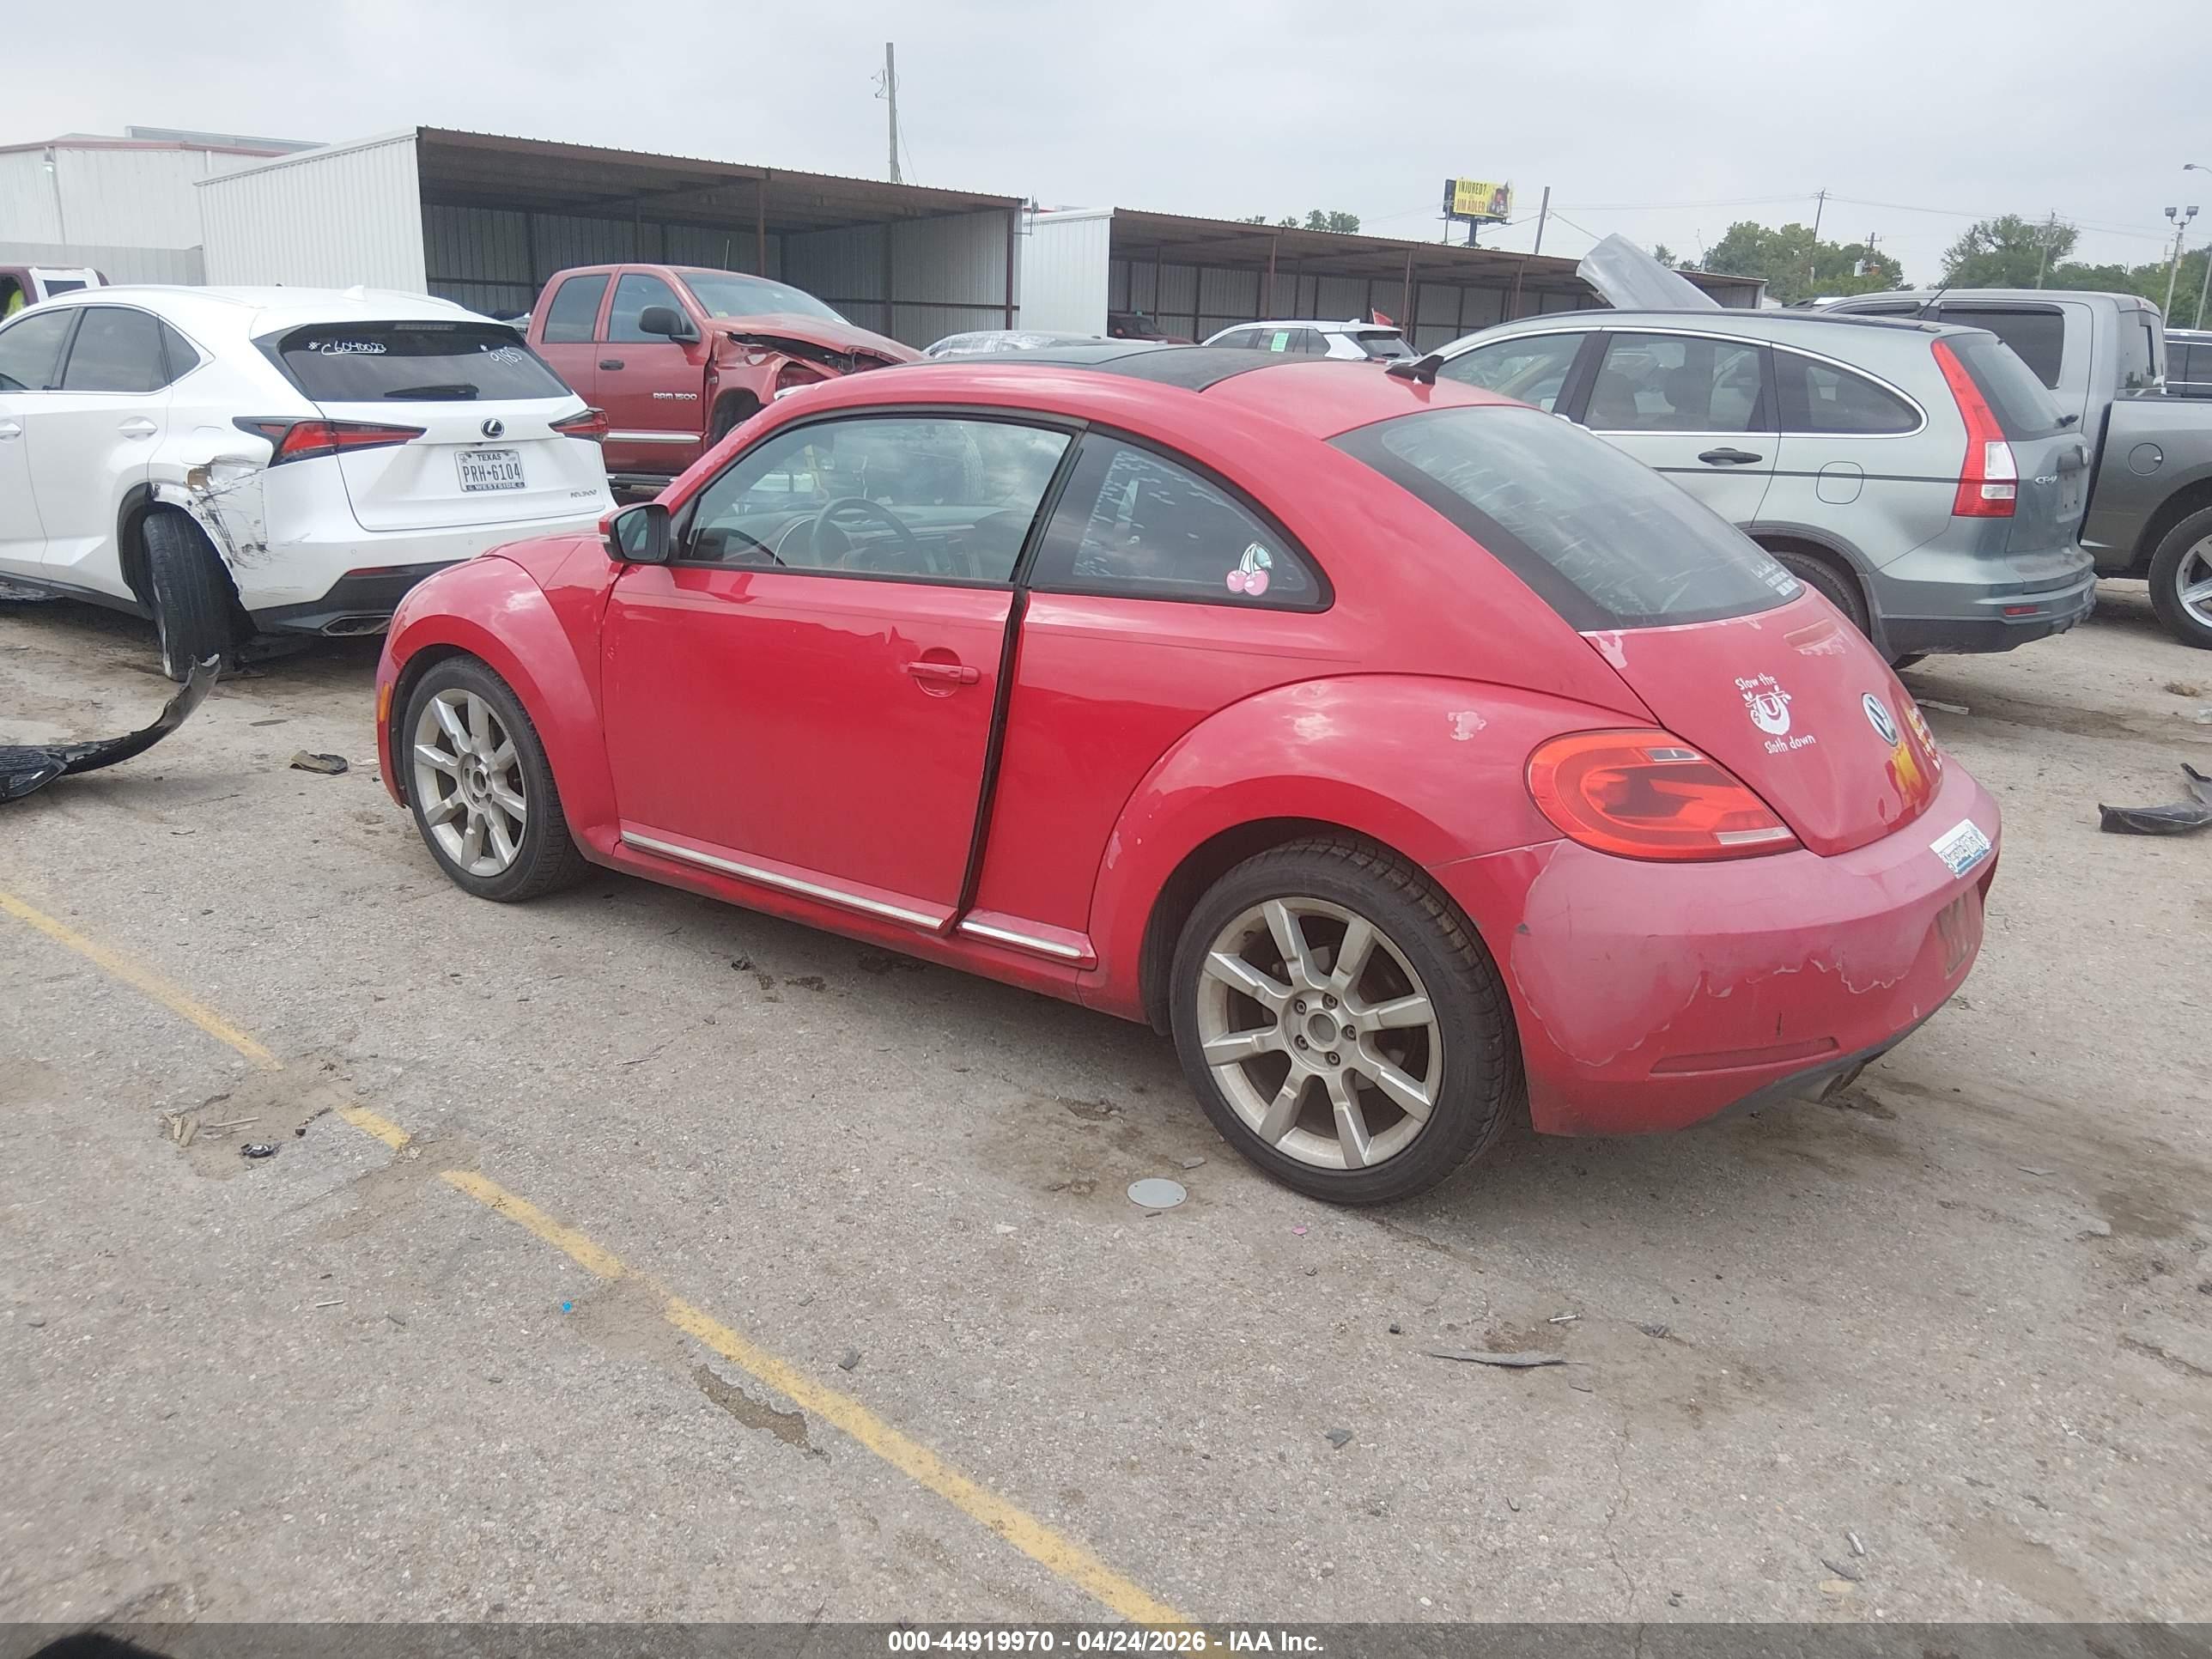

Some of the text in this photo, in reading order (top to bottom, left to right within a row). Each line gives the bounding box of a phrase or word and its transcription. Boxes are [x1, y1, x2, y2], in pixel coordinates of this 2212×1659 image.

[1459, 180, 1487, 197] INJURED?
[1467, 199, 1486, 214] ADLER
[1735, 672, 1778, 690] Slow the
[1764, 735, 1817, 754] Sloth down
